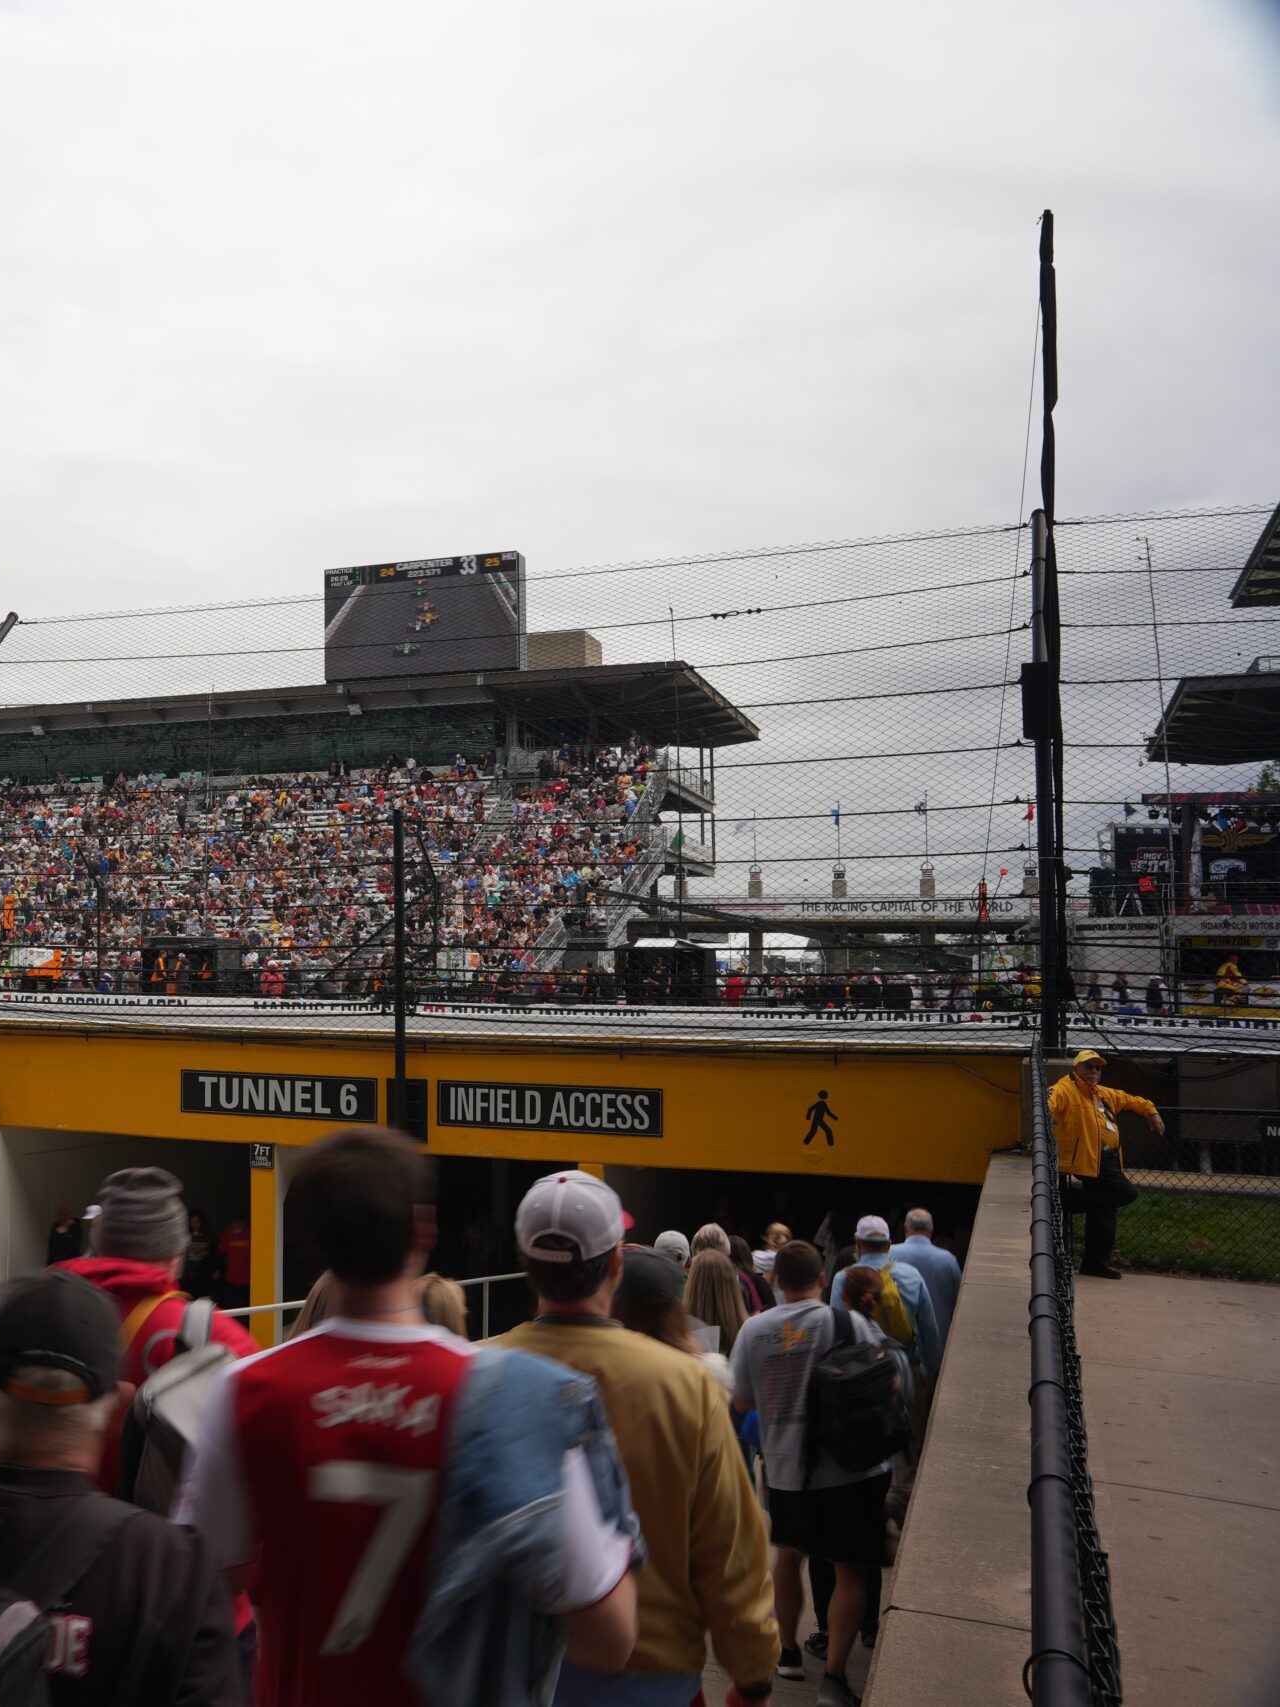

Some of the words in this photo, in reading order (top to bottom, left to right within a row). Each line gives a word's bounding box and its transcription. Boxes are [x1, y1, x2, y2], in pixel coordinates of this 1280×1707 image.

[396, 558, 453, 571] CARPENTER
[459, 556, 477, 575] 33
[484, 557, 501, 567] 25
[326, 567, 353, 575] PRACTICE
[801, 902, 823, 912] THE
[825, 902, 868, 912] RACING
[871, 902, 917, 912] CAPITAL
[921, 902, 938, 912] OF
[942, 902, 964, 912] THE
[199, 1076, 331, 1115] TUNNEL
[339, 1083, 358, 1116] 6
[449, 1086, 542, 1126] INFIELD
[549, 1091, 651, 1131] ACCESS
[253, 1143, 271, 1156] 7FT
[308, 1457, 441, 1656] 7
